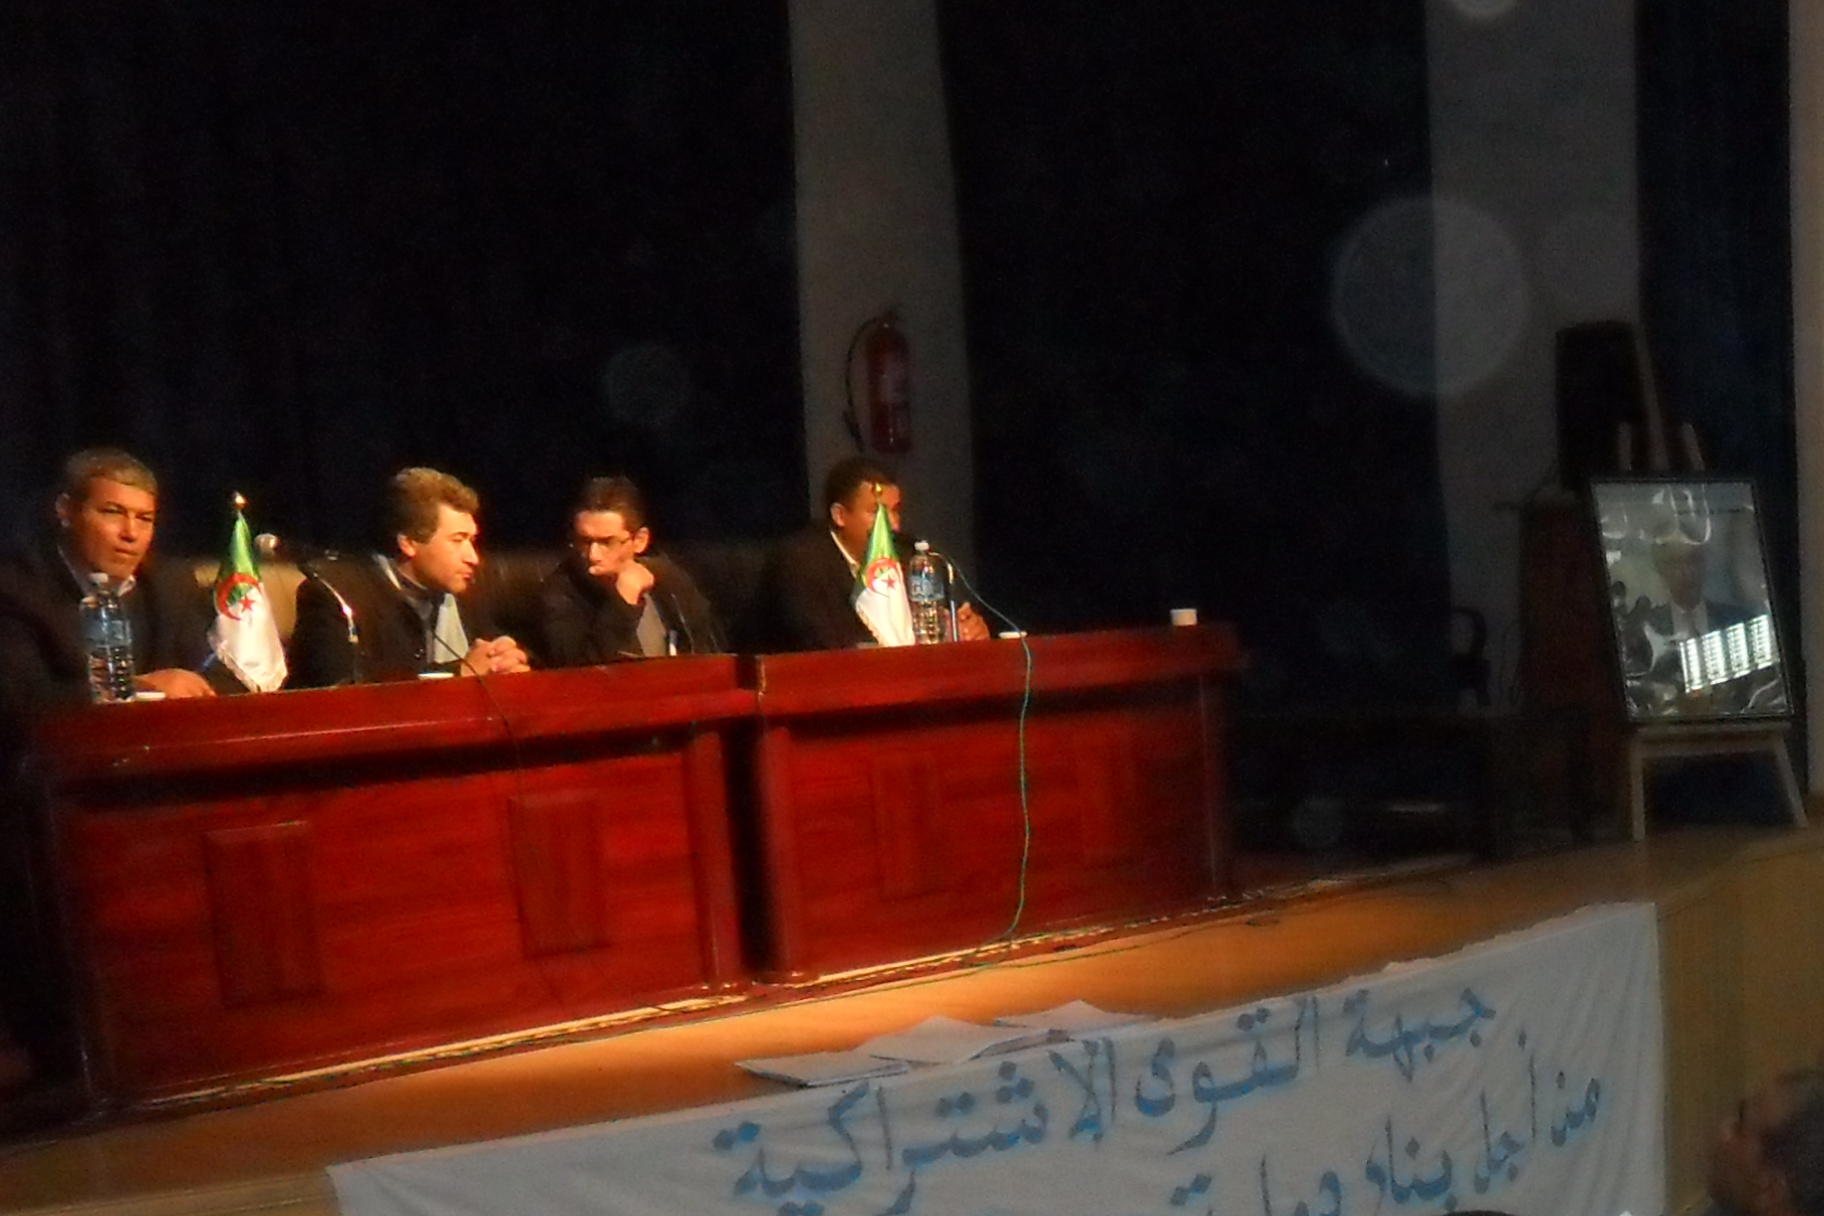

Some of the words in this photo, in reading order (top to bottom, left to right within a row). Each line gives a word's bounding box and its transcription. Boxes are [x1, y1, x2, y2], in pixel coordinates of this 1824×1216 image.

[1133, 993, 1321, 1157] القوى
[1342, 986, 1497, 1083] جبهة
[1550, 1069, 1601, 1148] من
